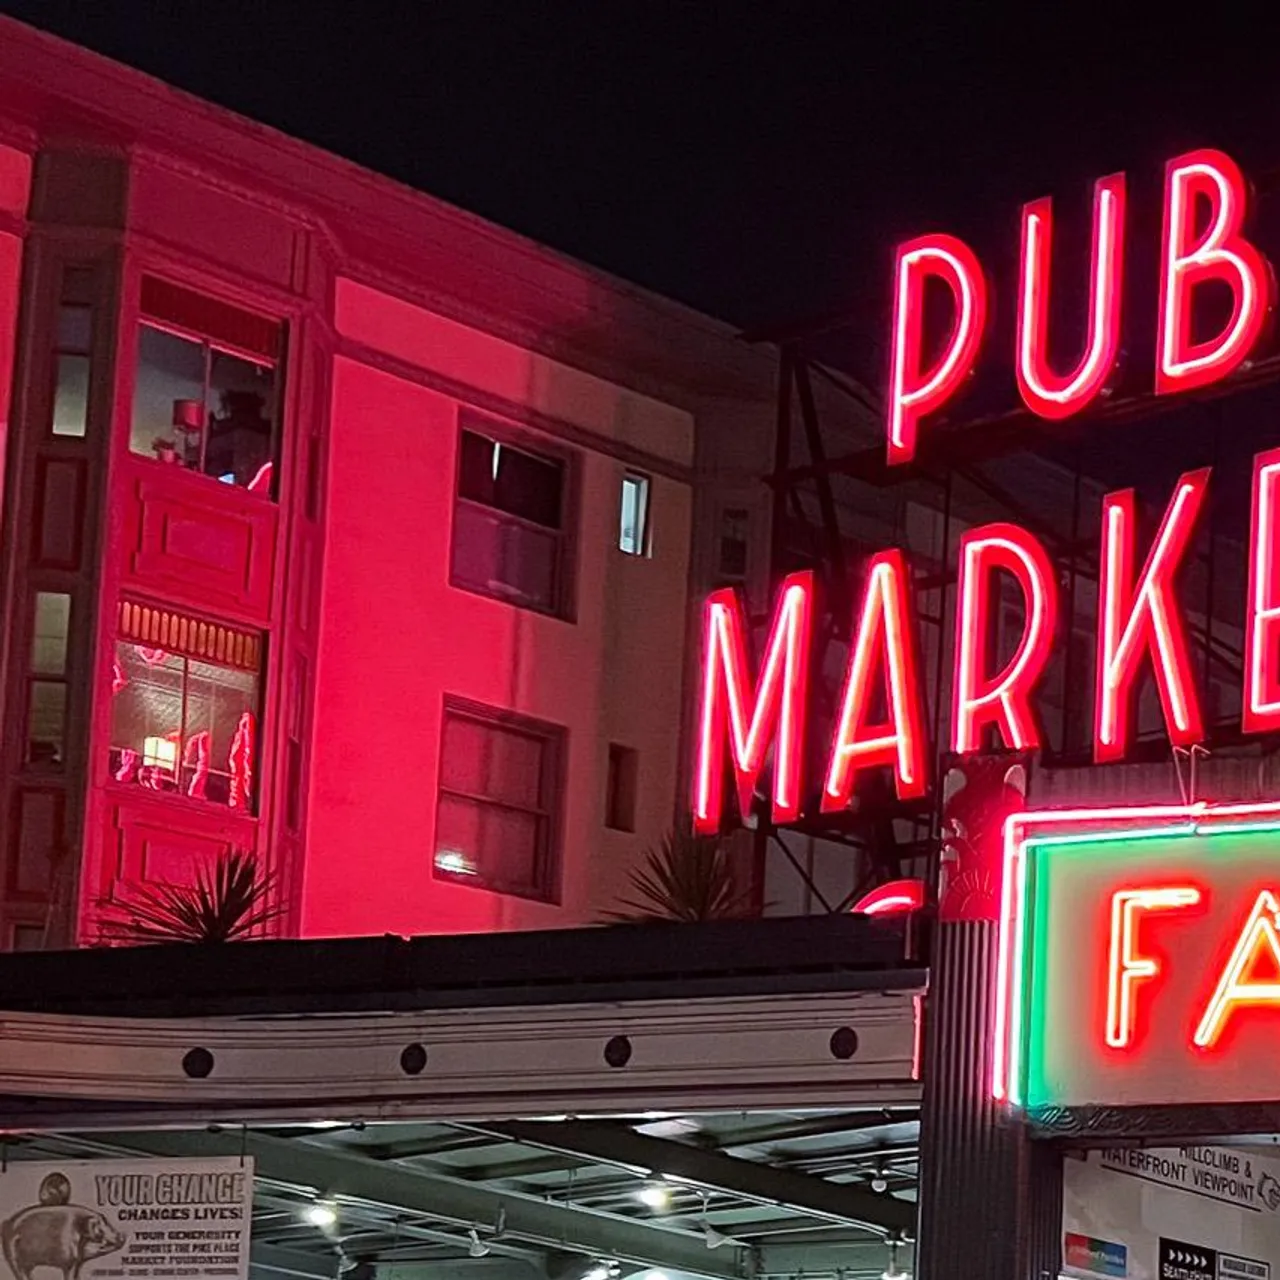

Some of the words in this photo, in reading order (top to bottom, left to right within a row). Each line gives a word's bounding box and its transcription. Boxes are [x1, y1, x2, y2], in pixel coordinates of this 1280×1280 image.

[1101, 1148, 1187, 1182] WATERFRONT
[1192, 1168, 1255, 1200] VIEWPOINT
[1179, 1147, 1240, 1174] HILLCLIMB
[1244, 1160, 1252, 1178] &
[95, 1174, 153, 1206] YOUR
[156, 1172, 245, 1205] CHANGE
[118, 1208, 190, 1221] CHANGES
[194, 1207, 243, 1220] LIVES!
